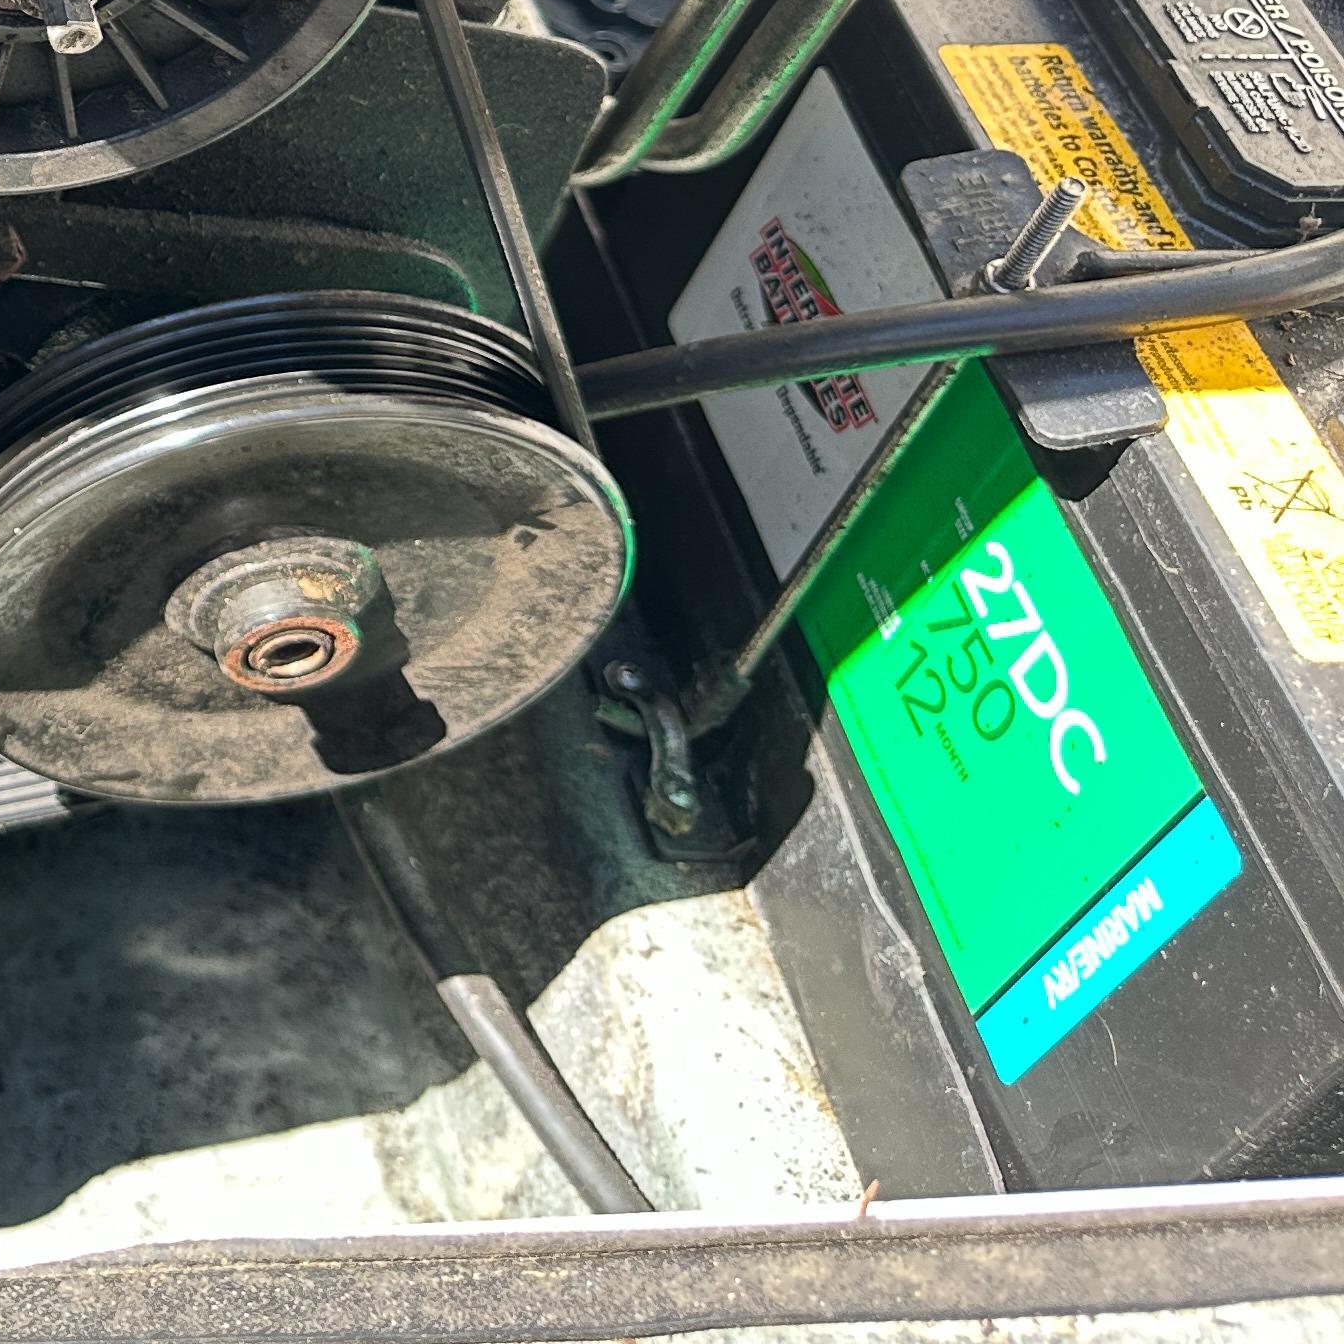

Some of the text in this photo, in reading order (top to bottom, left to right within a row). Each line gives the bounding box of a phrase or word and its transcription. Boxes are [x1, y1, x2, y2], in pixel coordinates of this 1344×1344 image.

[1008, 56, 1069, 133] batteries
[1058, 134, 1081, 153] to
[1040, 55, 1090, 114] Return
[1078, 115, 1144, 200] warranty
[1132, 199, 1177, 240] and
[754, 251, 848, 428] BATTES
[766, 223, 869, 423] INTERTE
[1228, 486, 1252, 511] Pb
[891, 637, 970, 784] 12 MONTH
[925, 579, 1017, 745] 750
[960, 540, 1108, 796] 27DC
[1045, 877, 1163, 1011] MARINE/RV
